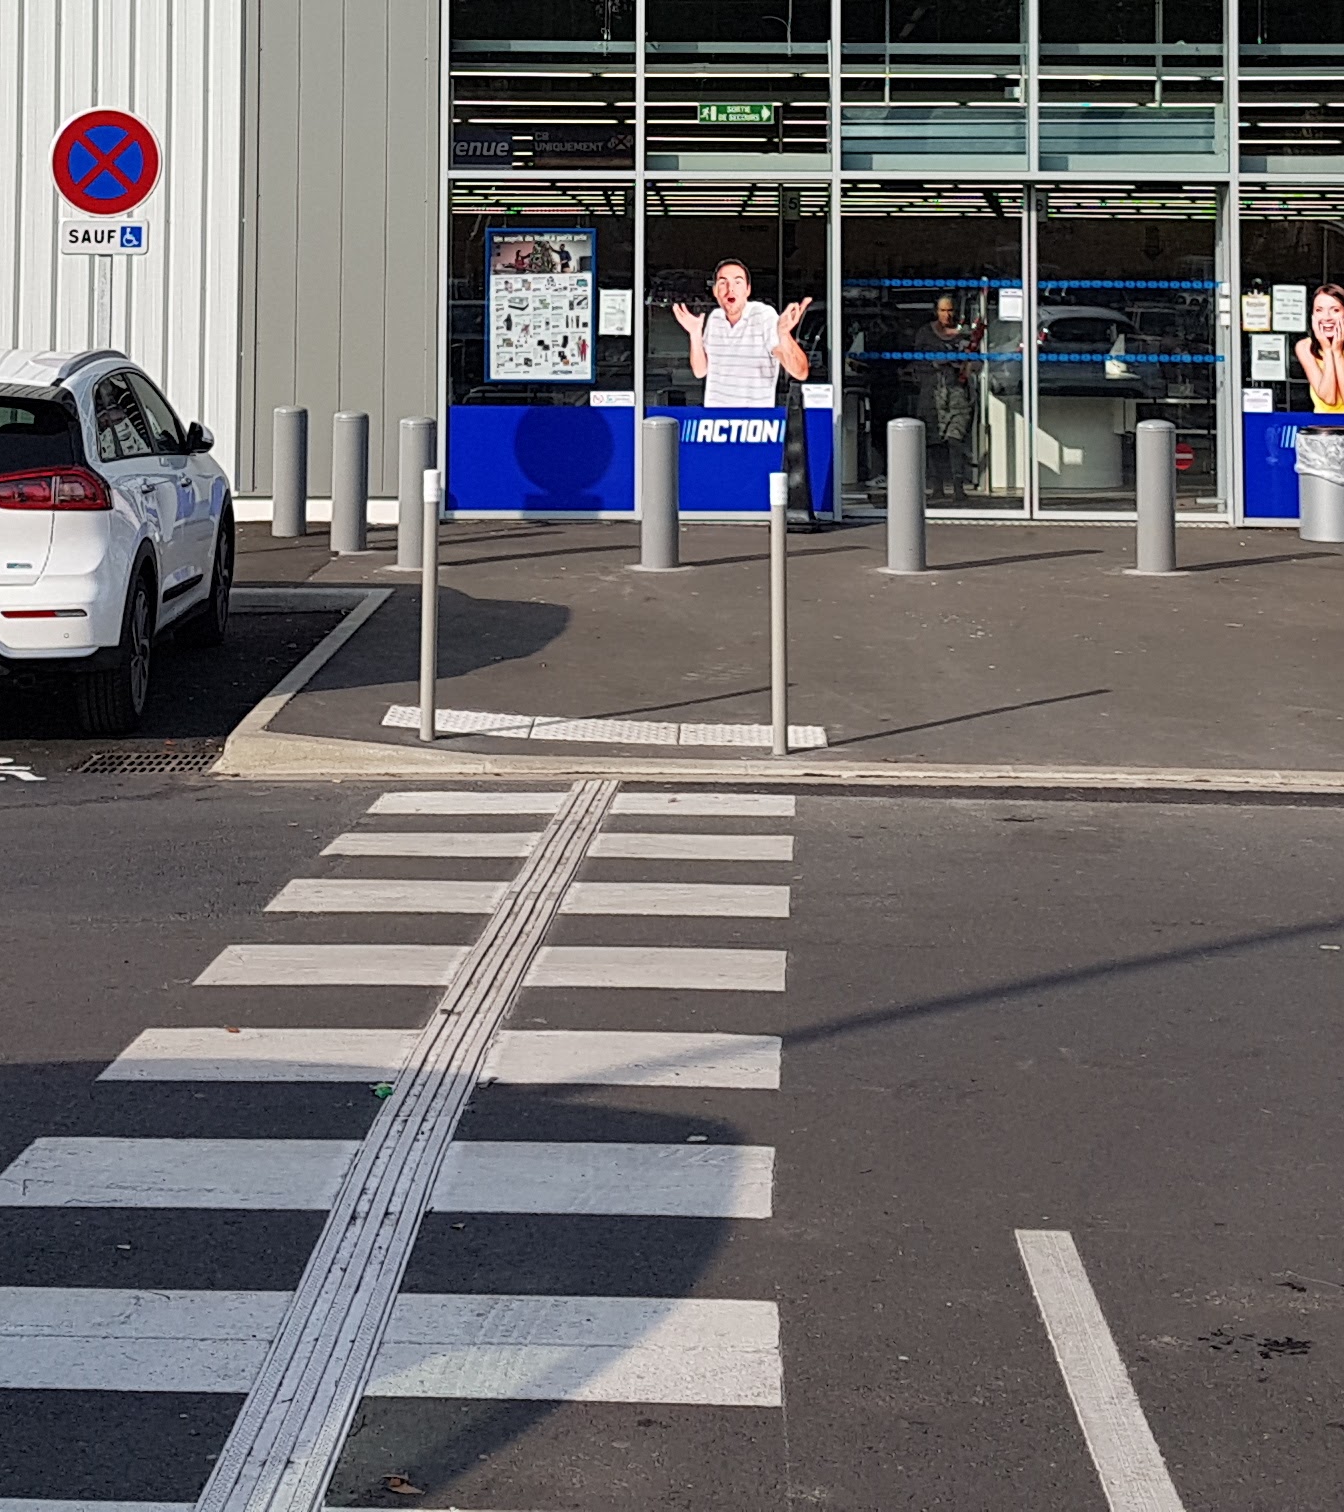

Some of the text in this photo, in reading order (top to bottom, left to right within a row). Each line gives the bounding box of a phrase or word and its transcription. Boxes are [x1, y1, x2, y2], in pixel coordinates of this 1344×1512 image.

[534, 141, 604, 152] UNIQUEMENT
[788, 196, 798, 211] 5
[68, 228, 116, 245] SAUF
[696, 419, 780, 443] ACTION
